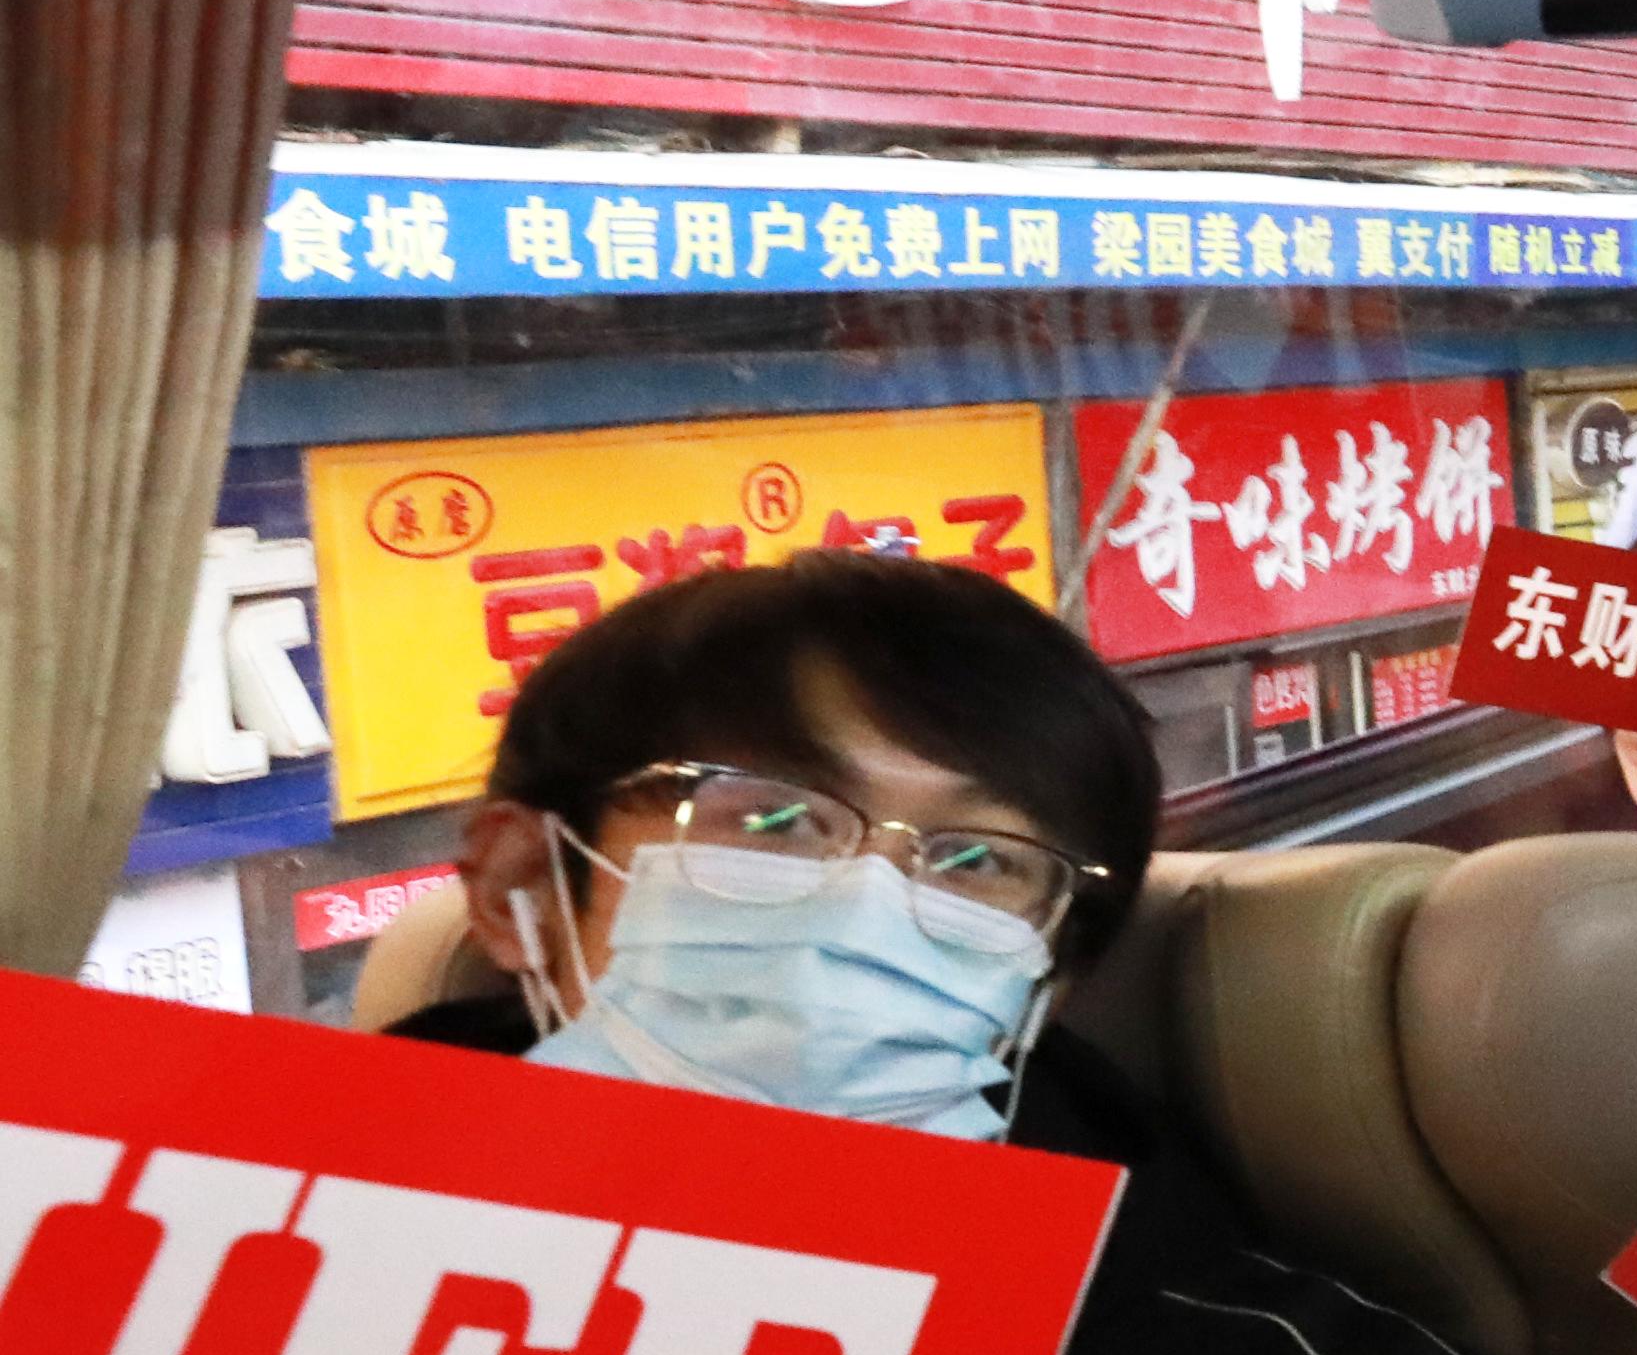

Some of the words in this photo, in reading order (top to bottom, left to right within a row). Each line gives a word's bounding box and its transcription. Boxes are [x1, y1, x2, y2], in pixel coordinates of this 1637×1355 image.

[265, 188, 456, 283] 食城
[505, 196, 1060, 281] 电信用户免费上网
[1092, 211, 1337, 279] 梁园美食城
[1356, 218, 1473, 280] 翼支付
[1488, 223, 1622, 278] 随机立减
[1107, 414, 1504, 620] 奇味烤饼
